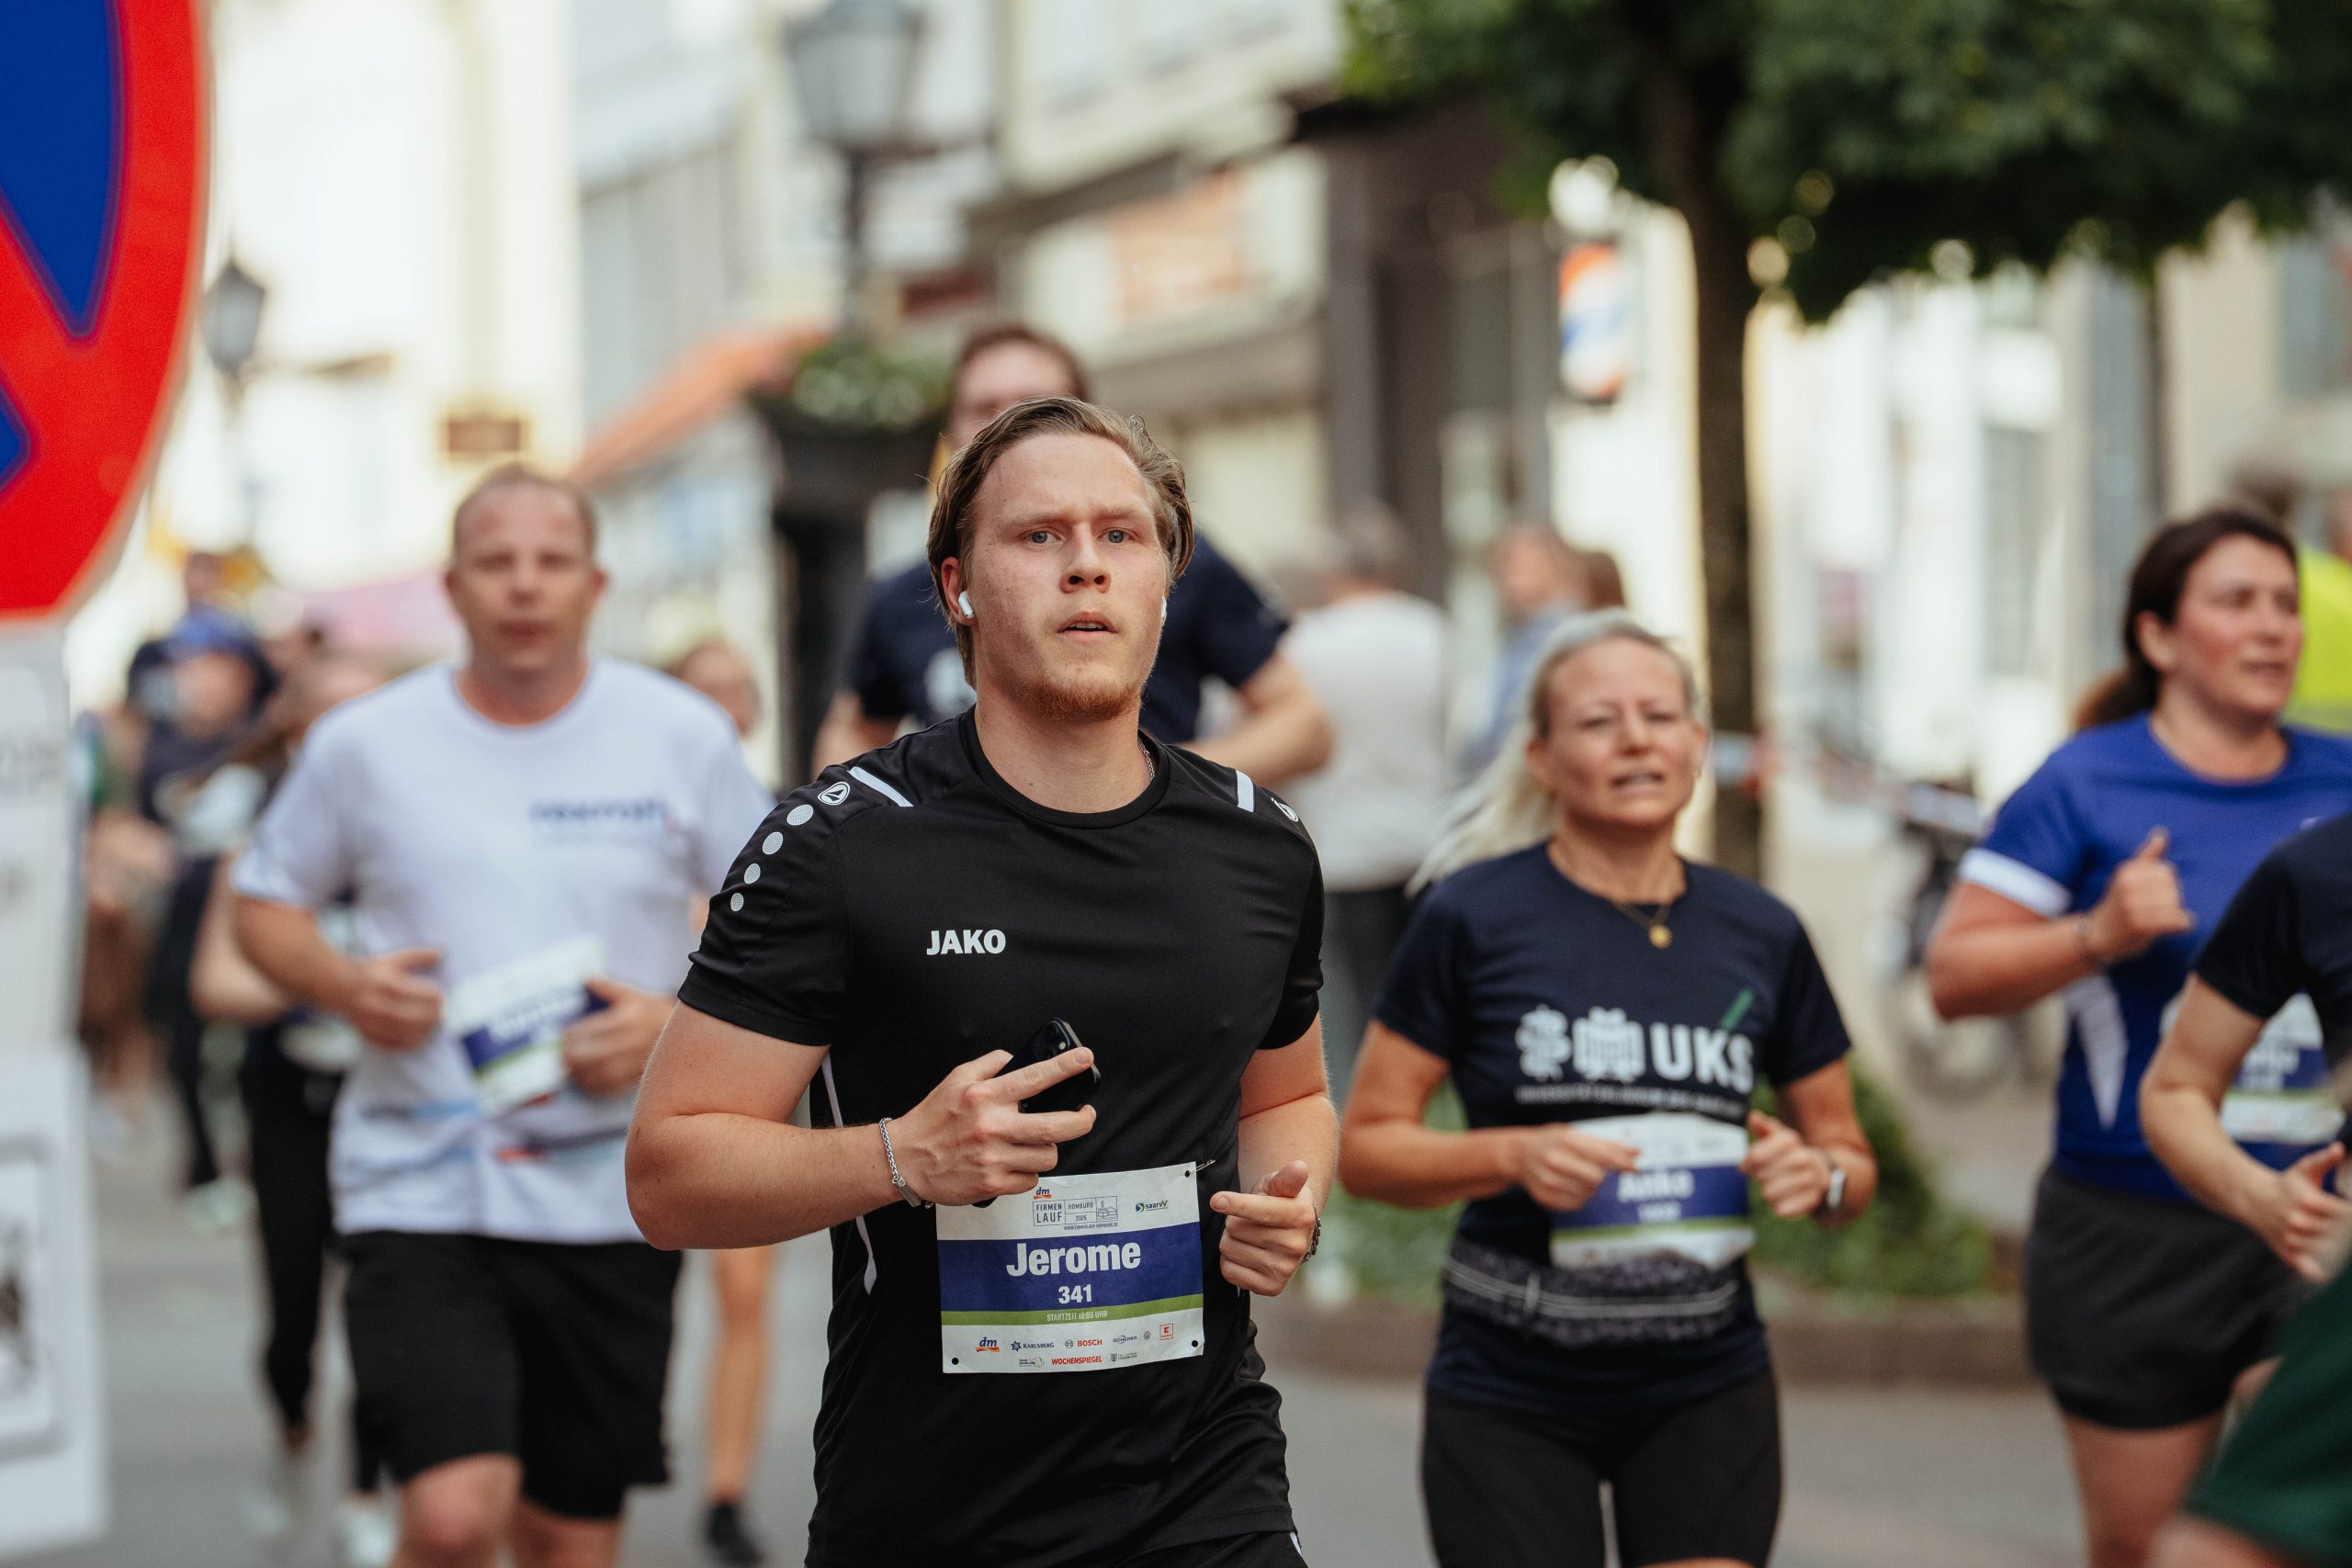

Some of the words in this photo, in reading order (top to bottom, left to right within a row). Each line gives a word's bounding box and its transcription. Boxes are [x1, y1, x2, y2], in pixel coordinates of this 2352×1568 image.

[927, 929, 1006, 955] JAKO
[1650, 1021, 1754, 1094] UKS
[1035, 1187, 1050, 1195] dm
[1035, 1203, 1062, 1212] FIRMEN
[1068, 1201, 1093, 1210] HOMBURG
[1036, 1212, 1062, 1224] LAUF
[1006, 1242, 1141, 1277] Jerome
[1058, 1284, 1092, 1304] 341
[1046, 1313, 1077, 1322] STARTZEIT
[1078, 1311, 1094, 1320] 18:00
[1094, 1310, 1108, 1318] UHR
[979, 1337, 997, 1348] dm
[1077, 1338, 1102, 1347] BOSCH
[1051, 1356, 1102, 1366] WOCHENSPIEGEL
